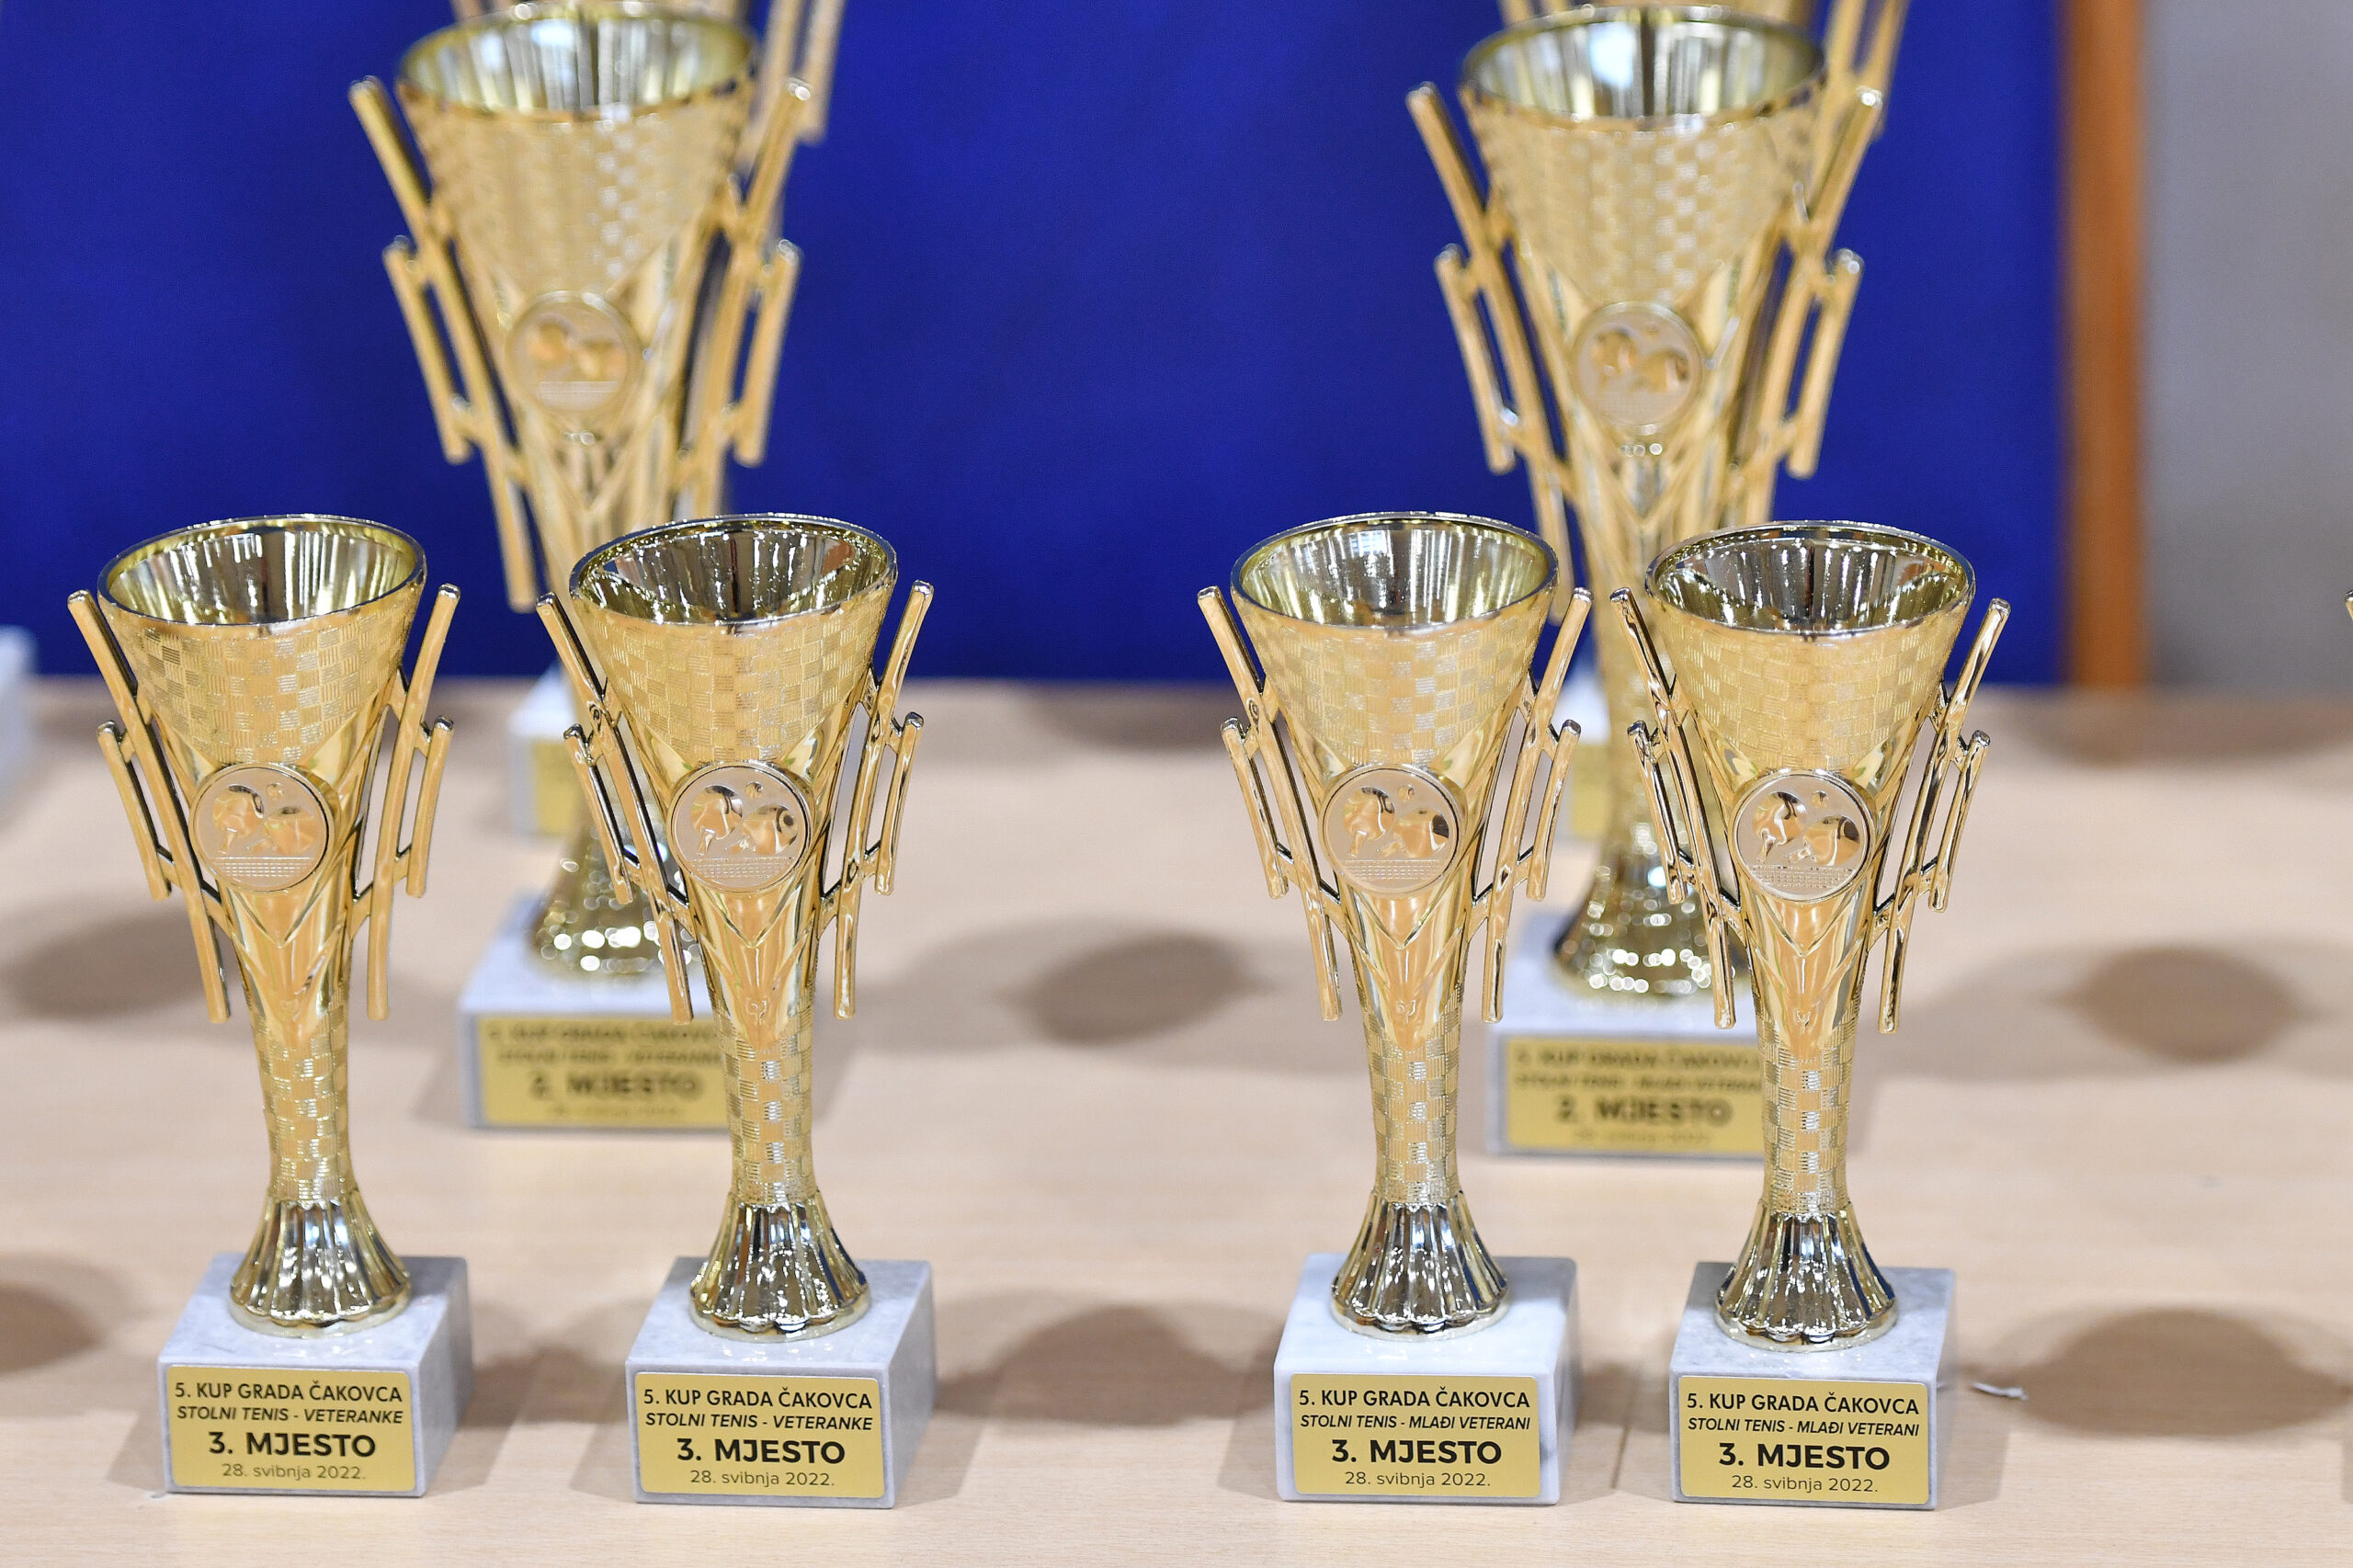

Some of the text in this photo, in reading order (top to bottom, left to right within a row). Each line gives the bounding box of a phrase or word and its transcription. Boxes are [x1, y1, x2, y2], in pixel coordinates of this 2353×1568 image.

[175, 1381, 402, 1403] 5. KUP GRADA ČAKOVCA
[643, 1388, 871, 1409] 5. KUP GRADA ČAKOVCA
[1300, 1387, 1529, 1408] 5. KUP GRADA ČAKOVCA
[1688, 1392, 1918, 1415] 5. KUP GRADA ČAKOVCA
[177, 1406, 236, 1419] STOLNI
[243, 1407, 289, 1421] TENIS
[304, 1409, 403, 1424] VETERANKE
[645, 1413, 705, 1426] STOLNI
[711, 1415, 757, 1427] TENIS
[774, 1416, 872, 1430] VETERANKE
[1301, 1415, 1351, 1426] STOLNI
[1357, 1415, 1396, 1427] TENIS
[1460, 1417, 1530, 1429] VETERANI
[1688, 1418, 1739, 1430] STOLNI
[1745, 1419, 1785, 1432] TENIS
[1847, 1422, 1919, 1436] VETERANI
[209, 1432, 376, 1457] 3. MJESTO
[676, 1438, 845, 1464] 3. MJESTO
[1332, 1439, 1502, 1464] 3. MJESTO
[1719, 1443, 1890, 1470] 3. MJESTO
[222, 1463, 366, 1481] 28. svibnja 2022.
[690, 1471, 834, 1487] 28. svibnja 2022.
[1346, 1471, 1490, 1488] 28. svibnja 2022.
[1732, 1475, 1878, 1493] 28. svibnja 2022.
